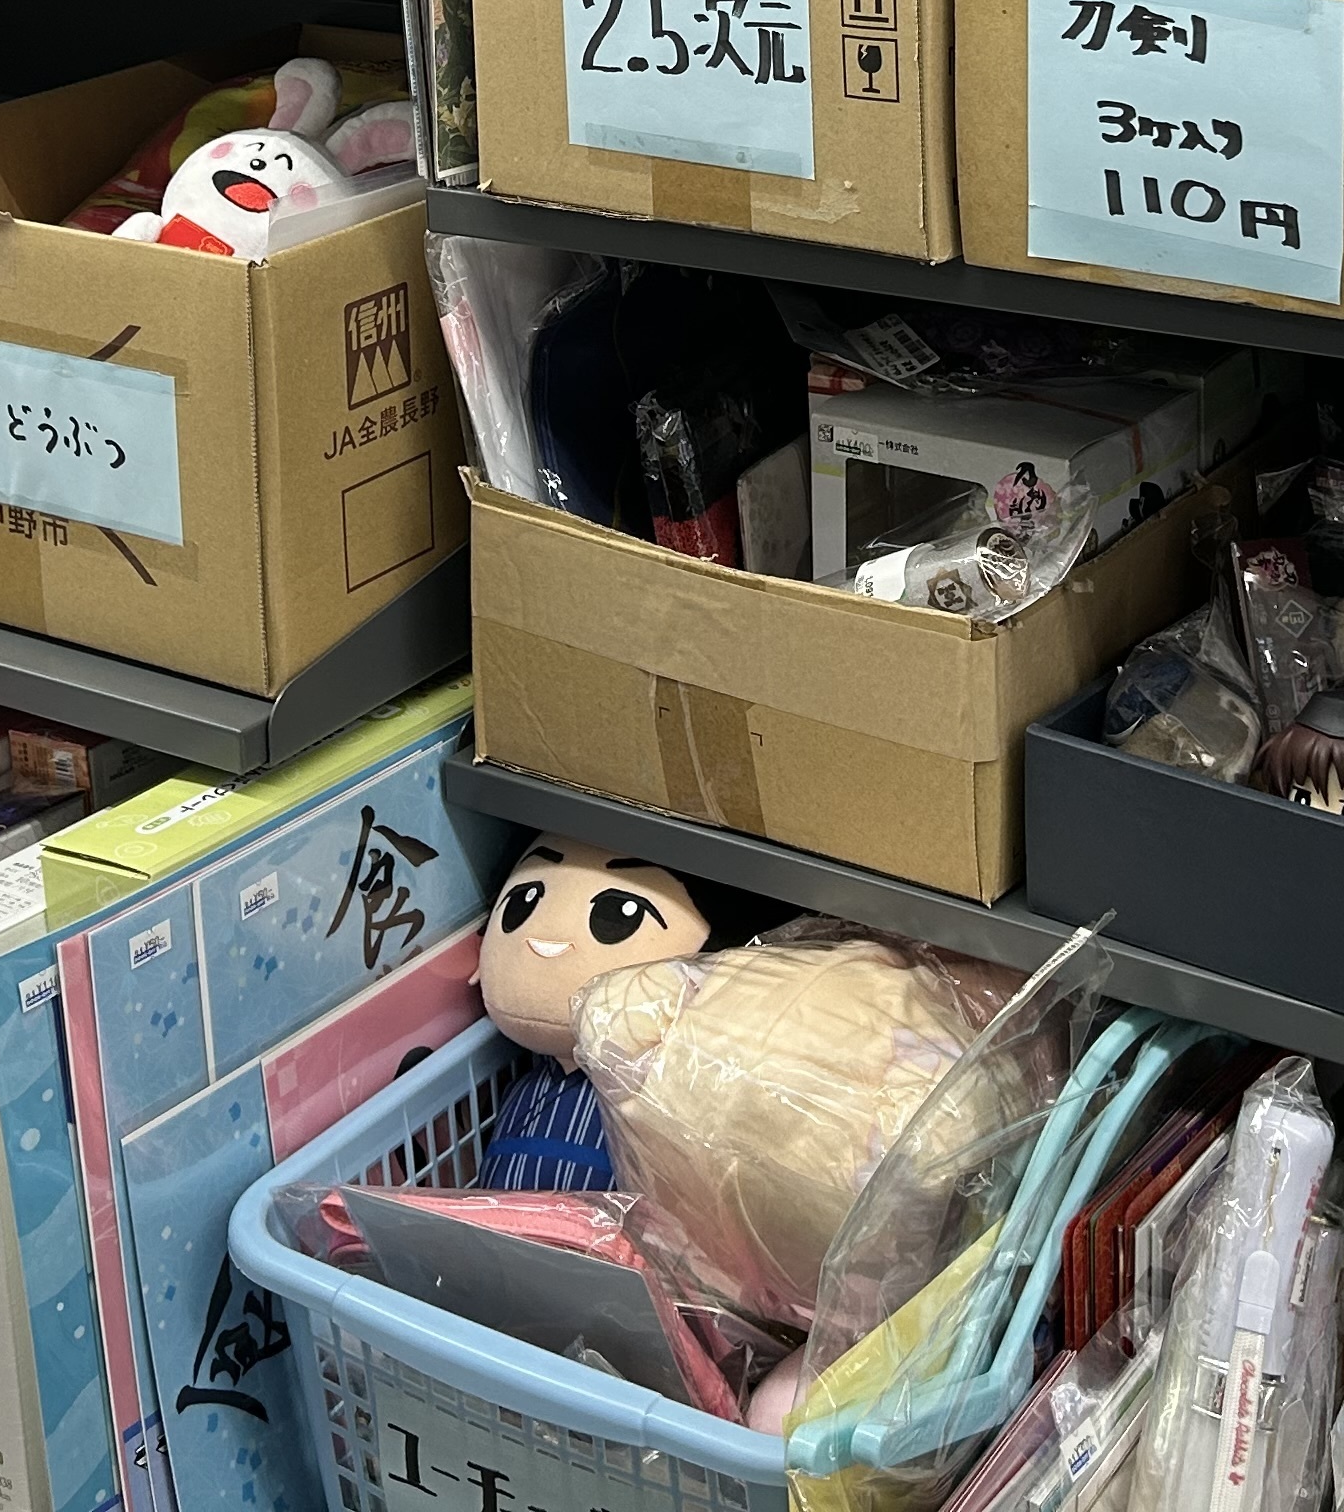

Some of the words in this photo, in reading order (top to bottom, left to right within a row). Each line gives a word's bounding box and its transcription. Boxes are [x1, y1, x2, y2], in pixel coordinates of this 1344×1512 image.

[1060, 0, 1209, 64] 刀剣
[1103, 168, 1301, 251] 110円
[346, 293, 408, 351] 信州
[323, 387, 440, 461] JA全農長野
[1237, 1359, 1256, 1420] Chocolate
